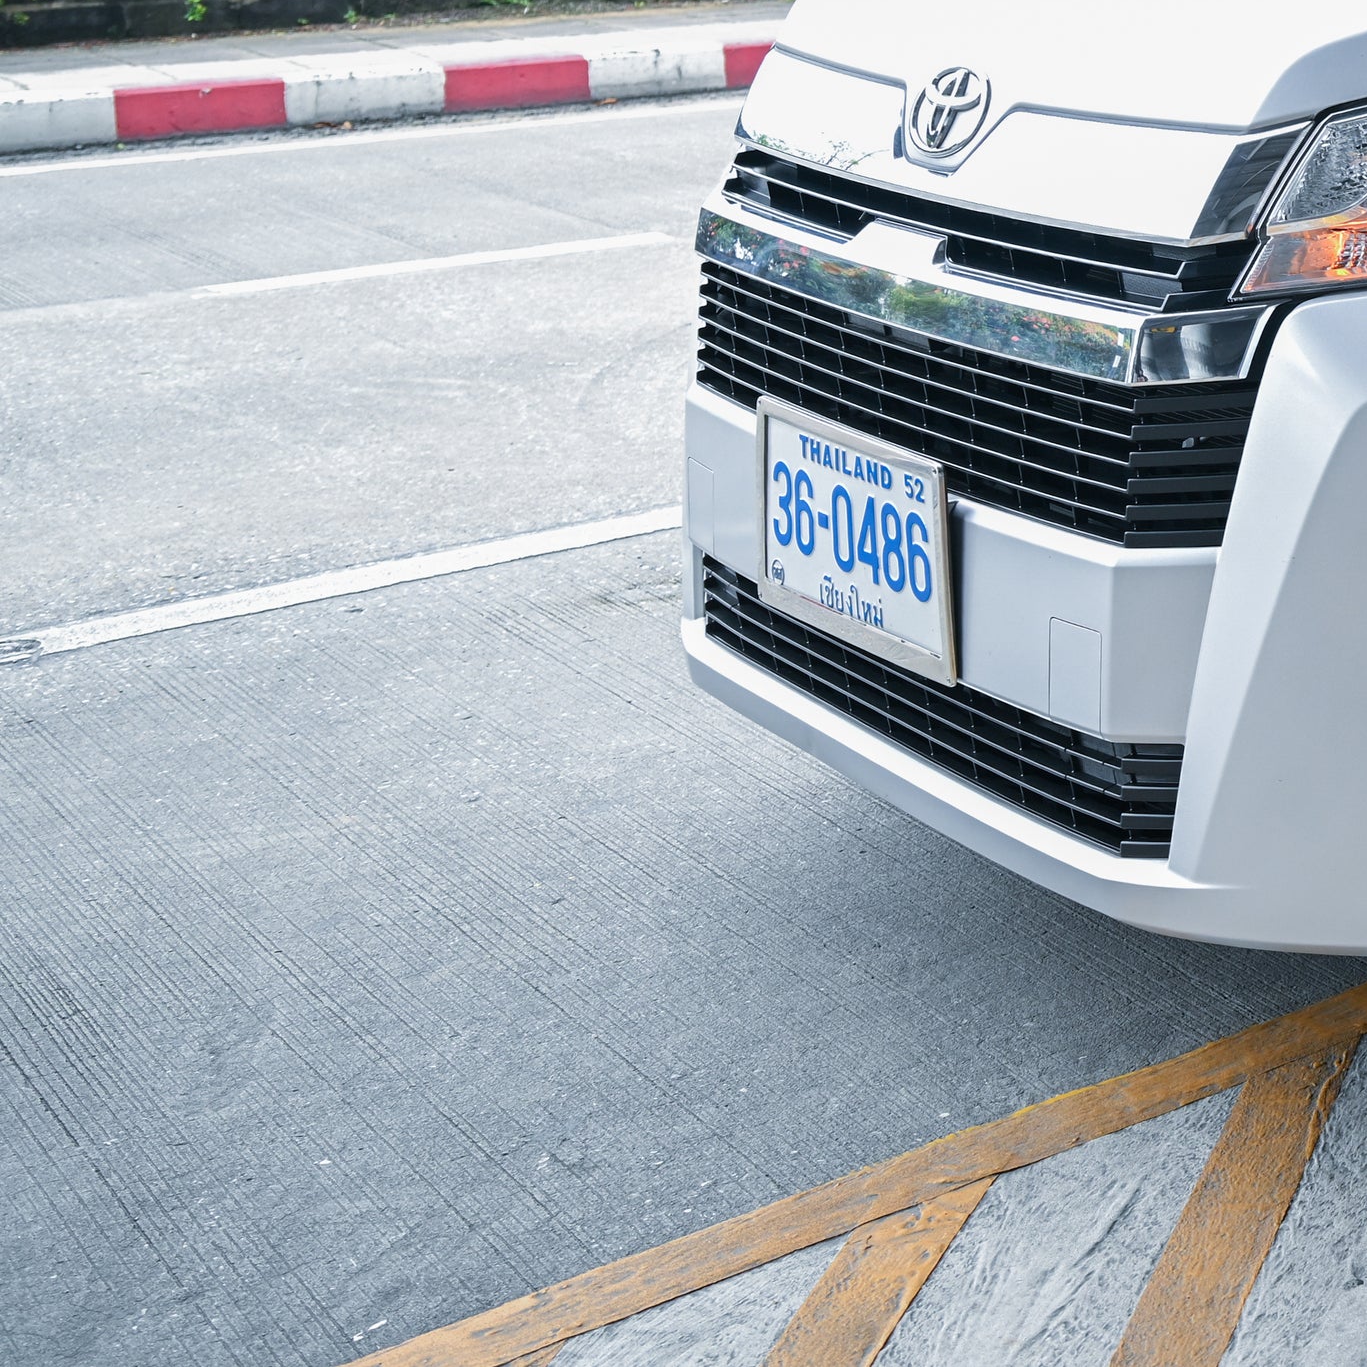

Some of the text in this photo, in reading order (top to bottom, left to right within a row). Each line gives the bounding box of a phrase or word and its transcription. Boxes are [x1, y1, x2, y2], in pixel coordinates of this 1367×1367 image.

[799, 434, 926, 503] THAILAND 52
[773, 461, 932, 602] 36-0486
[819, 575, 884, 628] เชียงใหม่
